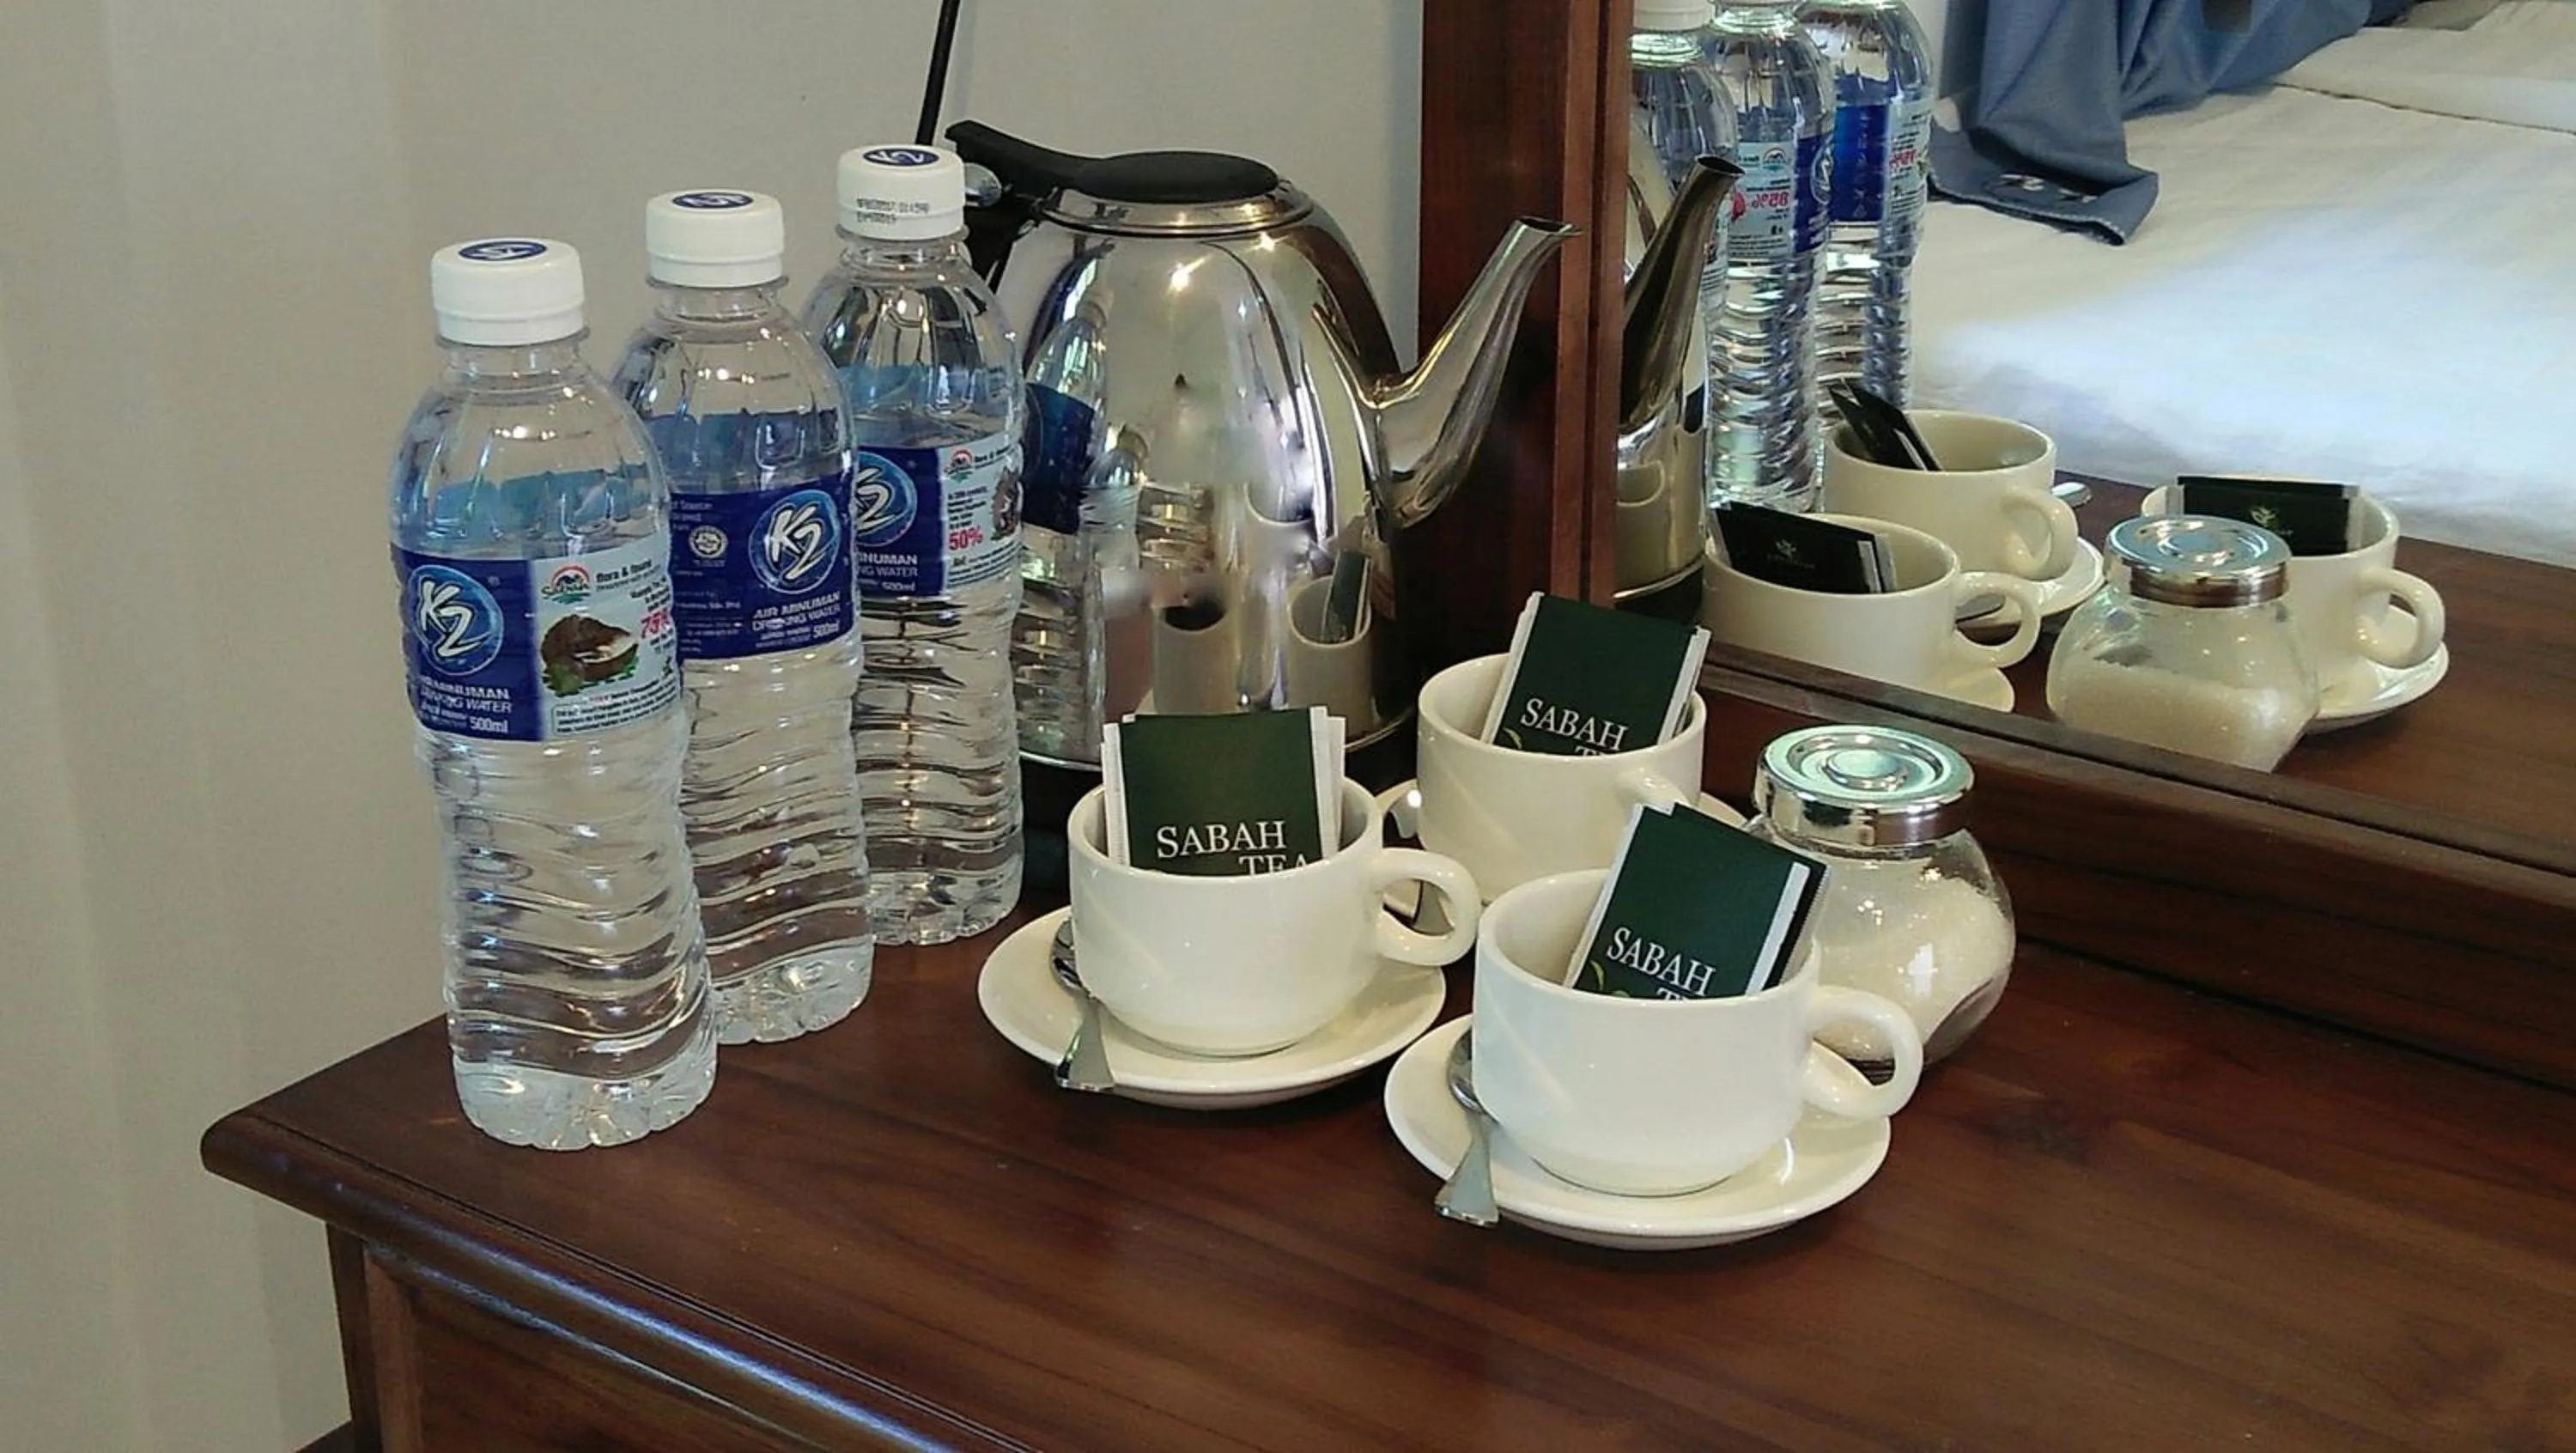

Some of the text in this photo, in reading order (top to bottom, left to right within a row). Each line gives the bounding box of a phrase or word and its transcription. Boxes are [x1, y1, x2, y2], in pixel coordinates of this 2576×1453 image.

[770, 504, 827, 581] K2
[948, 526, 984, 551] 50%
[418, 578, 491, 659] K2
[752, 606, 779, 620] AIR
[465, 698, 513, 714] WATER
[469, 715, 508, 733] 500ml
[1521, 697, 1630, 751] SABAH
[1156, 820, 1288, 859] SABAH
[1606, 927, 1717, 997] SABAH
